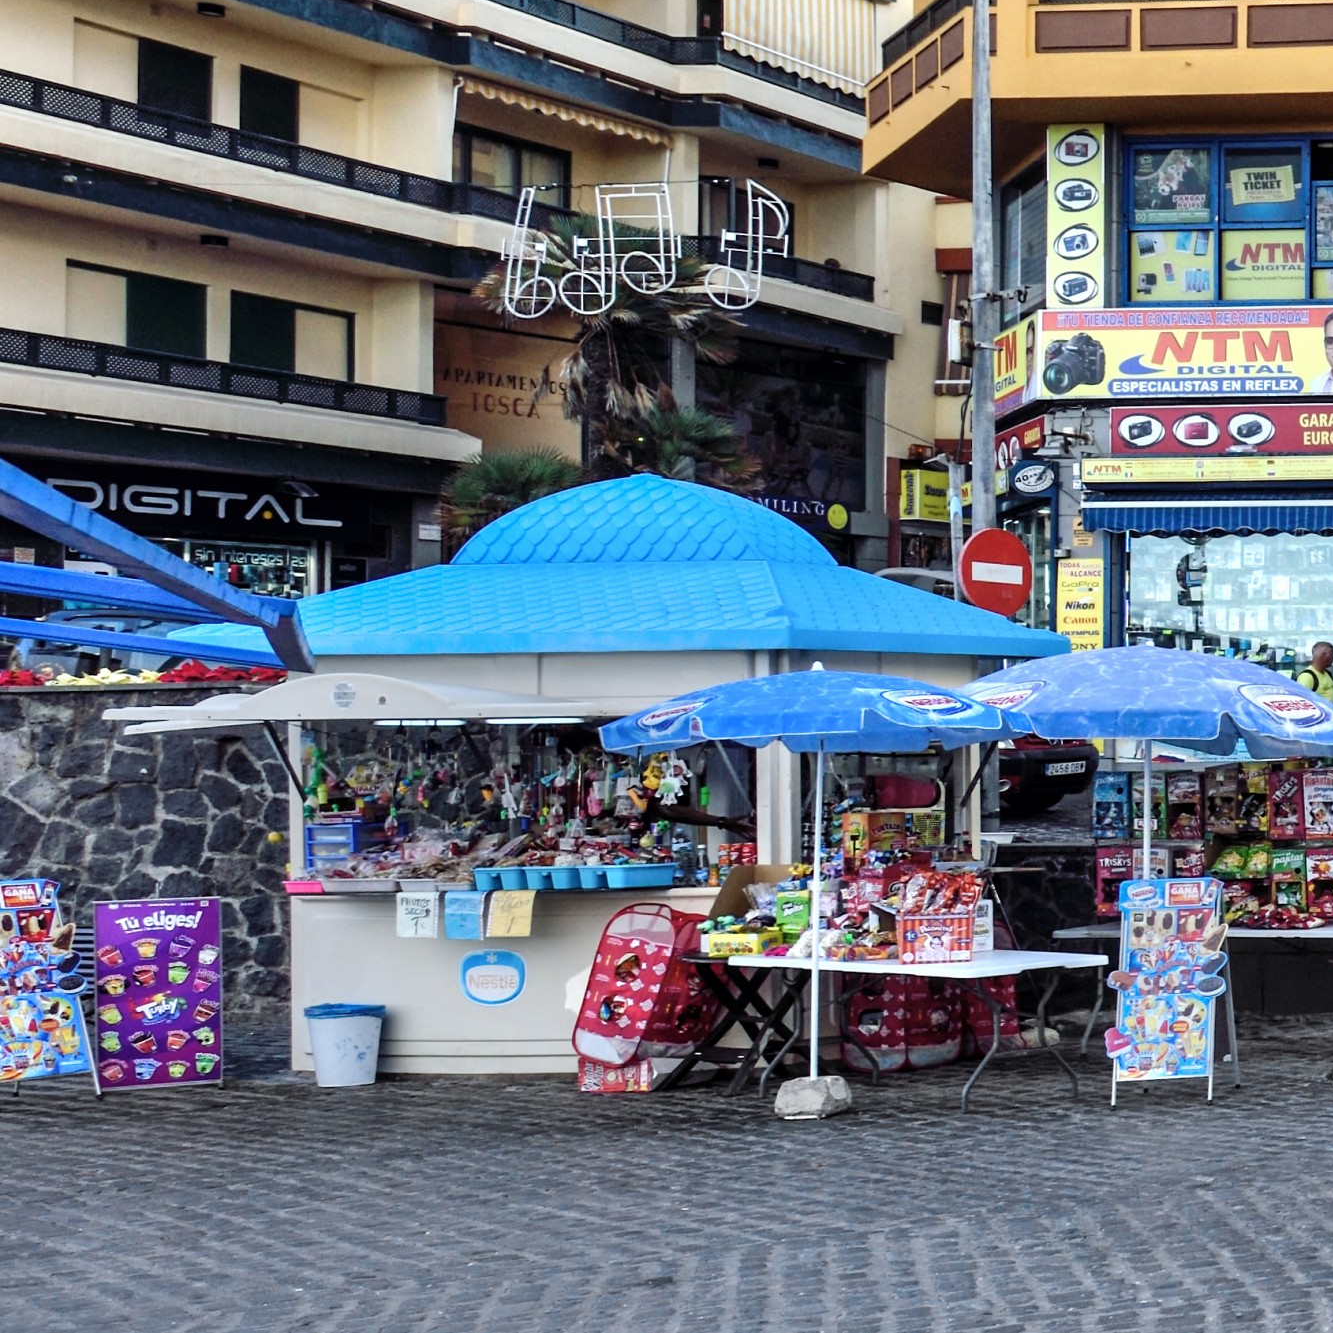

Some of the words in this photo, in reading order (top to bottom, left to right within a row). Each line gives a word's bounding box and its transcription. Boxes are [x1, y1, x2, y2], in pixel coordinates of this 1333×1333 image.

[1245, 171, 1278, 182] TWIN
[1242, 179, 1283, 191] TICKET
[1240, 243, 1305, 265] NTM
[1082, 313, 1126, 327] TIENDA
[1128, 313, 1143, 326] DE
[1146, 311, 1213, 326] CONFIANZA
[995, 331, 1017, 377] TM
[1151, 331, 1294, 365] NTM
[1176, 365, 1293, 375] DIGITAL
[443, 366, 568, 396] APARTAMENOS
[995, 376, 1017, 393] GITAL
[1112, 381, 1219, 393] ESPECIALISTAS
[1222, 380, 1241, 392] EN
[1244, 379, 1299, 391] REFLEX
[472, 392, 541, 419] TOSCA
[1093, 464, 1122, 473] NTM
[1015, 474, 1029, 484] 40
[47, 477, 343, 527] DIGITAL
[749, 497, 825, 516] MILING
[195, 548, 215, 562] sin
[221, 548, 283, 567] intereses
[1065, 601, 1096, 610] Nikon
[1063, 616, 1098, 625] Canon
[1262, 695, 1318, 714] Nestlé
[1099, 858, 1132, 867] TRISKYS
[1273, 854, 1304, 868] pajitas
[4, 888, 33, 897] GANA
[1171, 886, 1199, 895] GANA
[115, 916, 140, 931] Tú
[143, 910, 203, 931] eliges!
[468, 974, 518, 989] Nestlé
